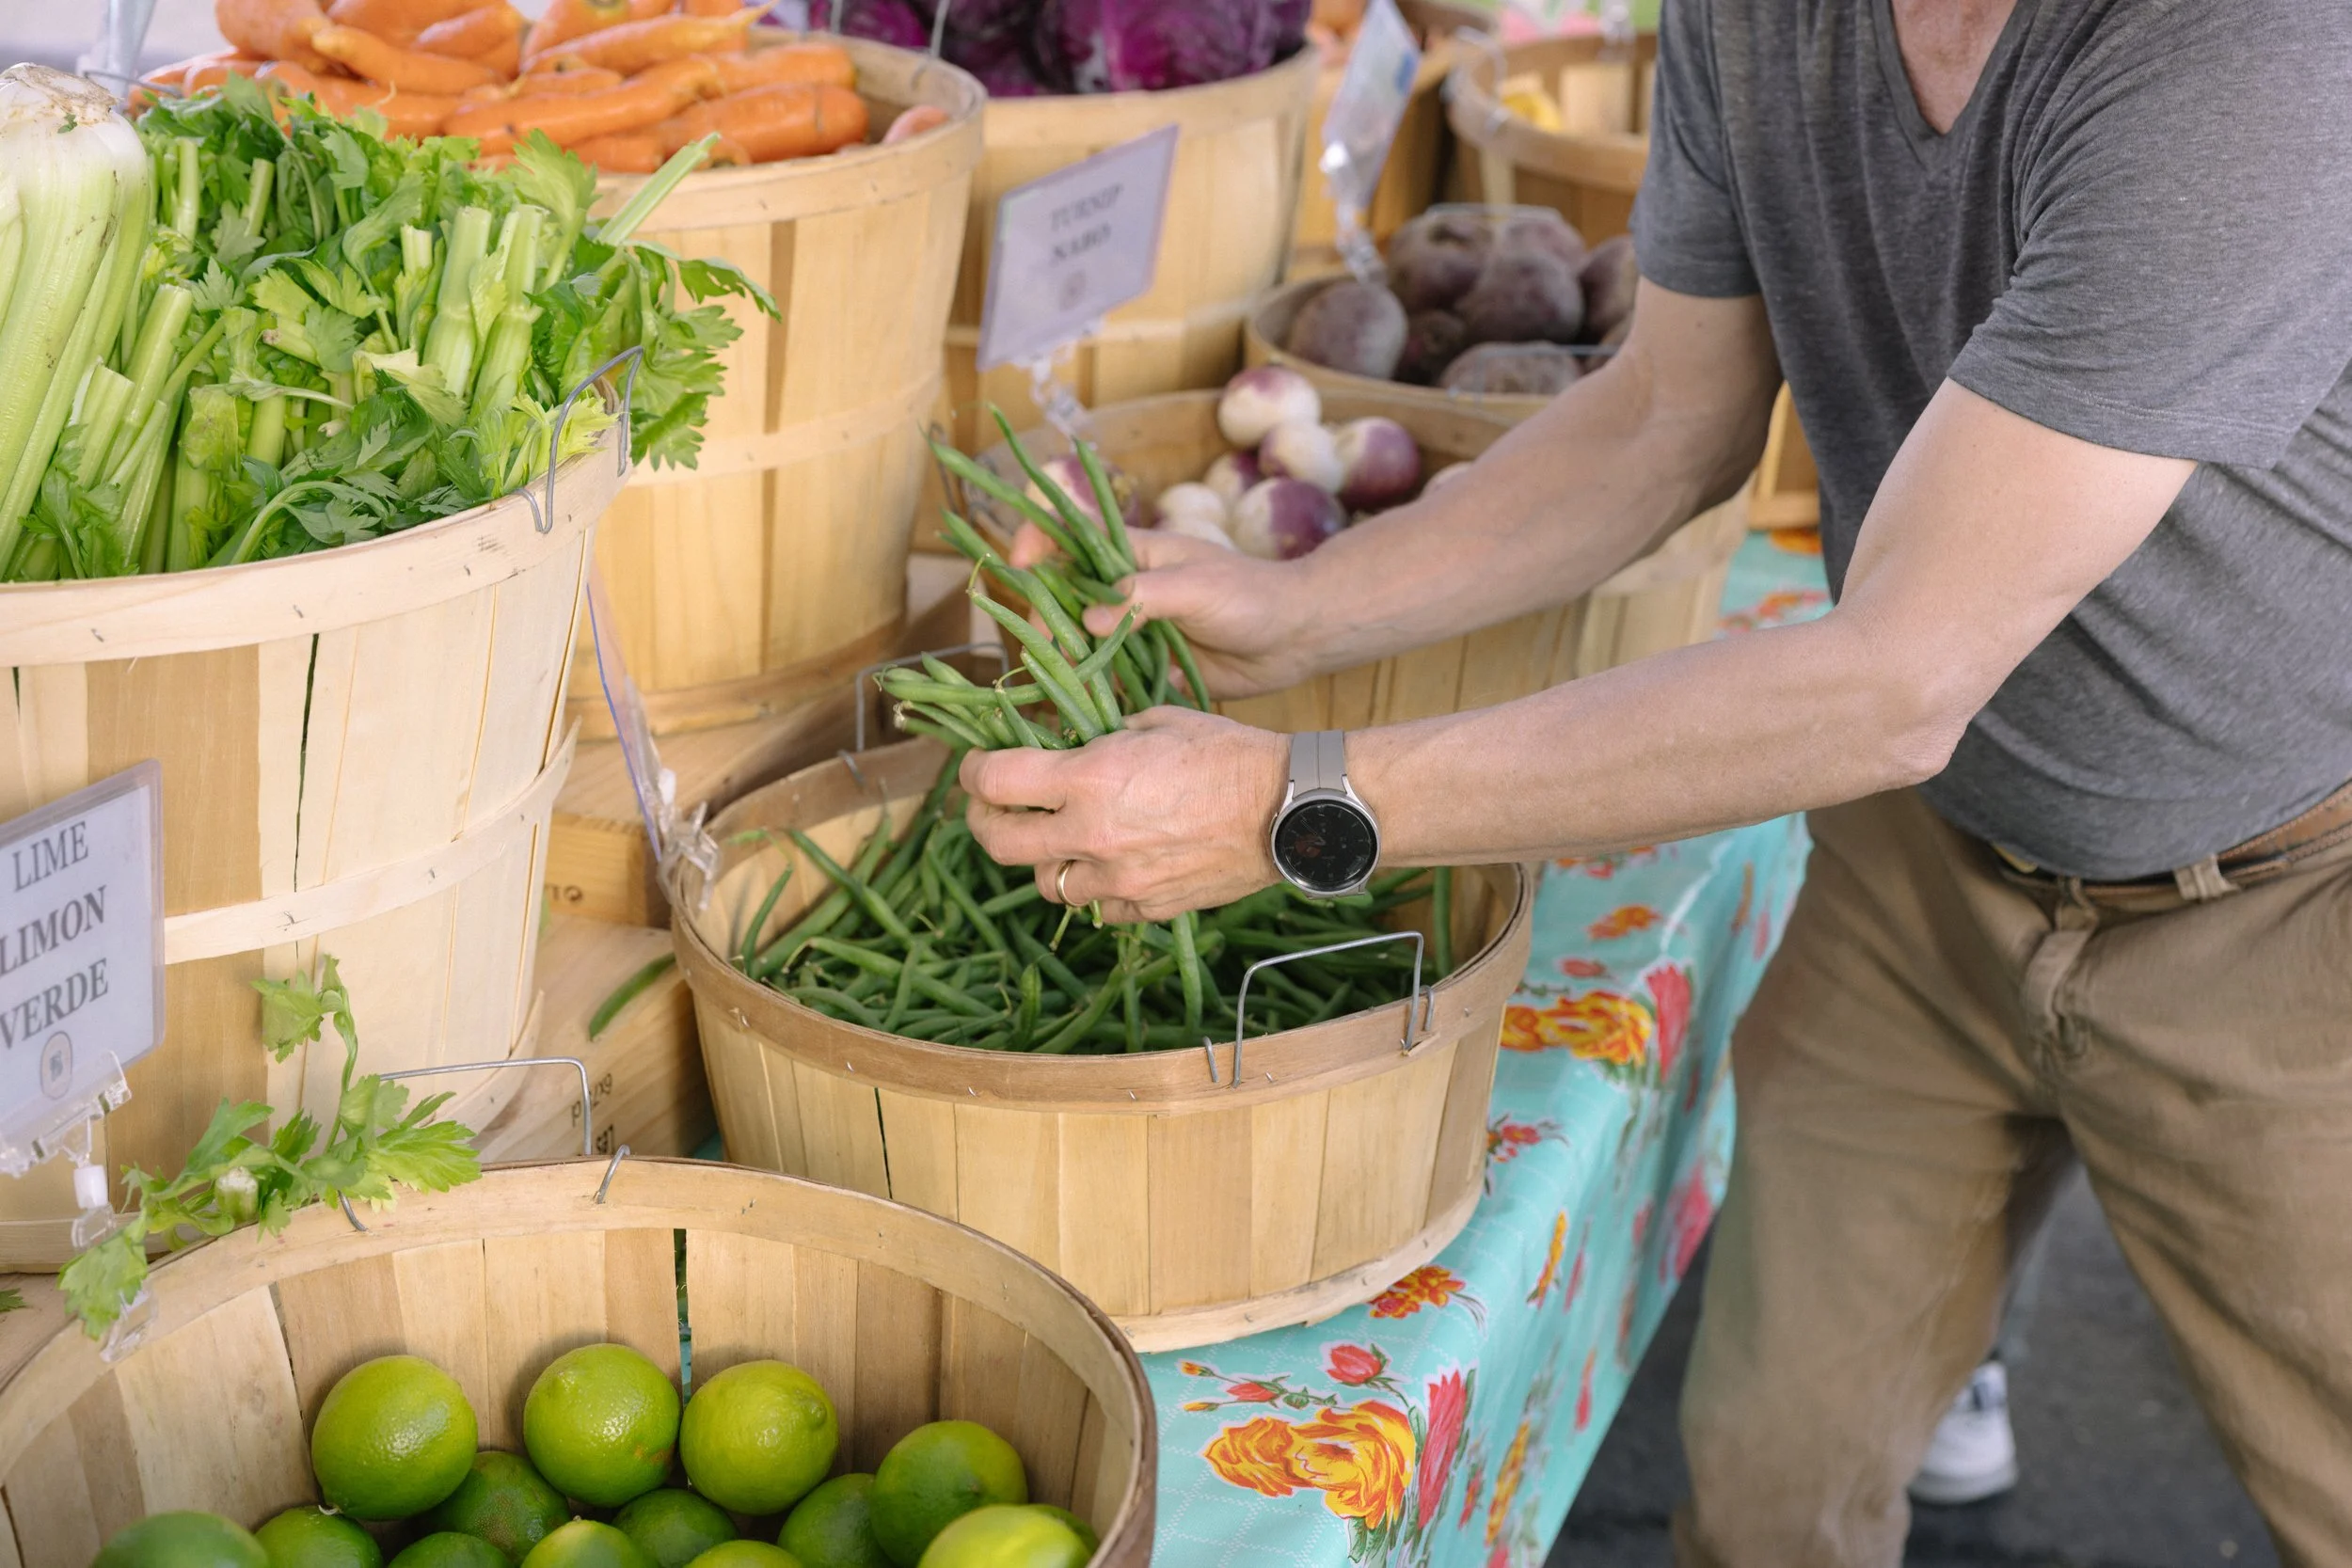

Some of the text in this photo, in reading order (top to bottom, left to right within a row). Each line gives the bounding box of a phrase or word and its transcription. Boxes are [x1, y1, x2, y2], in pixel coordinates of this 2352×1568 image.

[12, 821, 88, 892] LIME
[0, 885, 106, 976] LIMON
[0, 958, 108, 1050] VERDE
